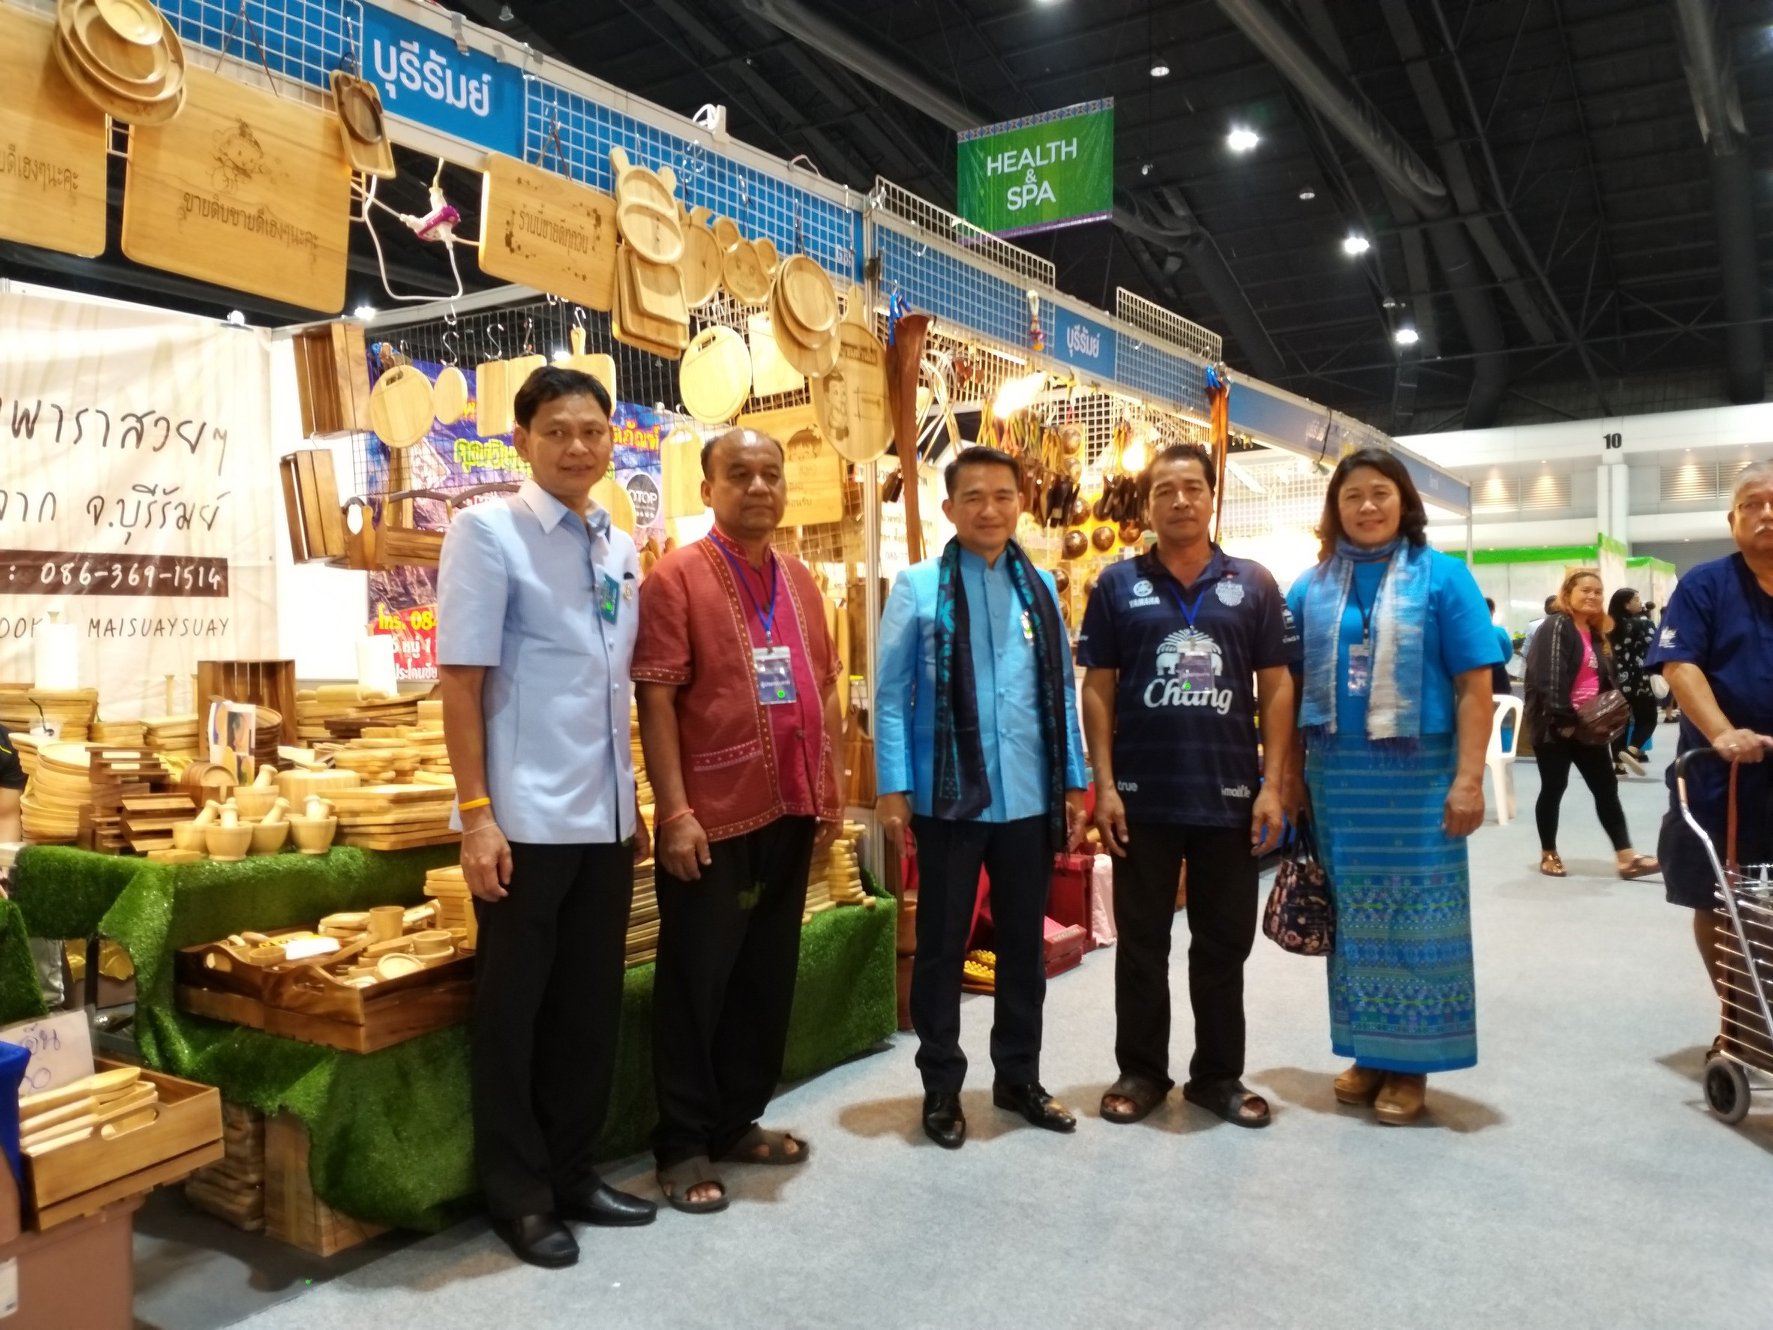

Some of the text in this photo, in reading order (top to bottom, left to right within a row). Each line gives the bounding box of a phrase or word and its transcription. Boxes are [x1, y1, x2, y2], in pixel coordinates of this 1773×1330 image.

[373, 39, 492, 117] บุรีรัมย์
[986, 137, 1078, 177] HEALTH
[1025, 168, 1037, 184] &
[1006, 180, 1057, 211] SPA
[1066, 323, 1101, 359] บุรีรัมย์
[1602, 432, 1622, 450] 10
[629, 489, 658, 504] OTOP
[40, 562, 222, 590] 086-369-1514
[1128, 596, 1161, 608] YAMAHA
[87, 617, 230, 639] MAISUAYSUAY
[1143, 678, 1234, 715] Chang
[1116, 780, 1139, 792] true
